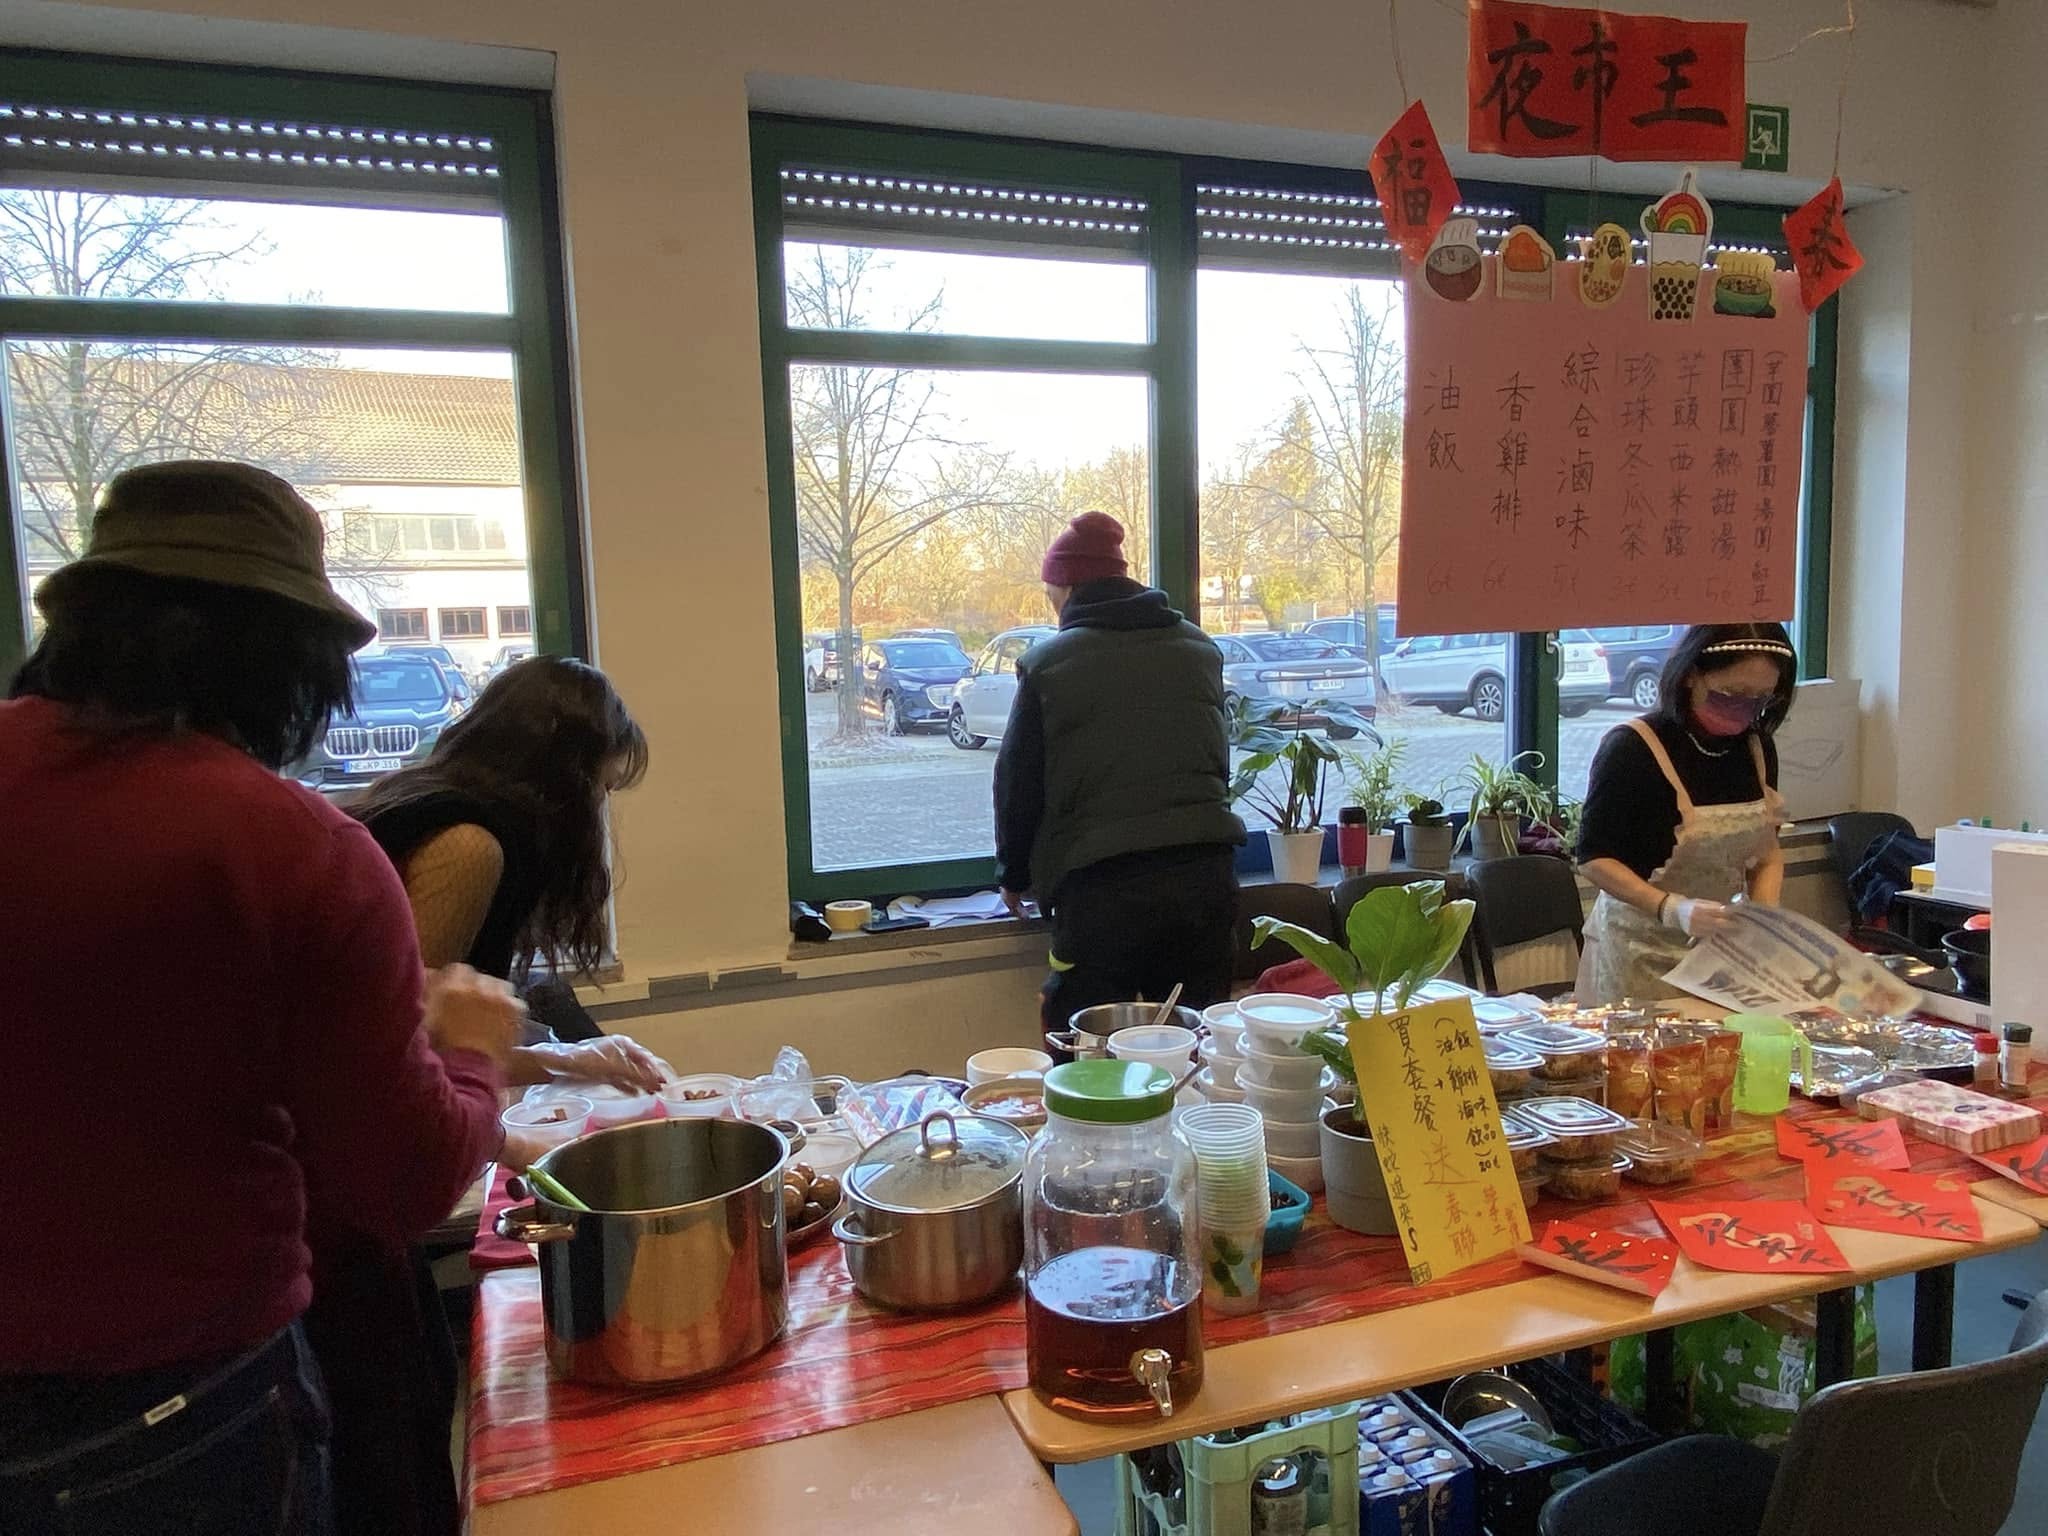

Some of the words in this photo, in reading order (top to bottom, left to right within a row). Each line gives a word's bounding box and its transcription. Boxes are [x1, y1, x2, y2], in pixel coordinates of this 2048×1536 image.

[1477, 20, 1729, 149] 夜市王
[1381, 134, 1433, 231] 福
[1423, 364, 1464, 472] 油飯
[1489, 370, 1536, 534] 香雞排
[1554, 341, 1601, 551] 綜合滷味
